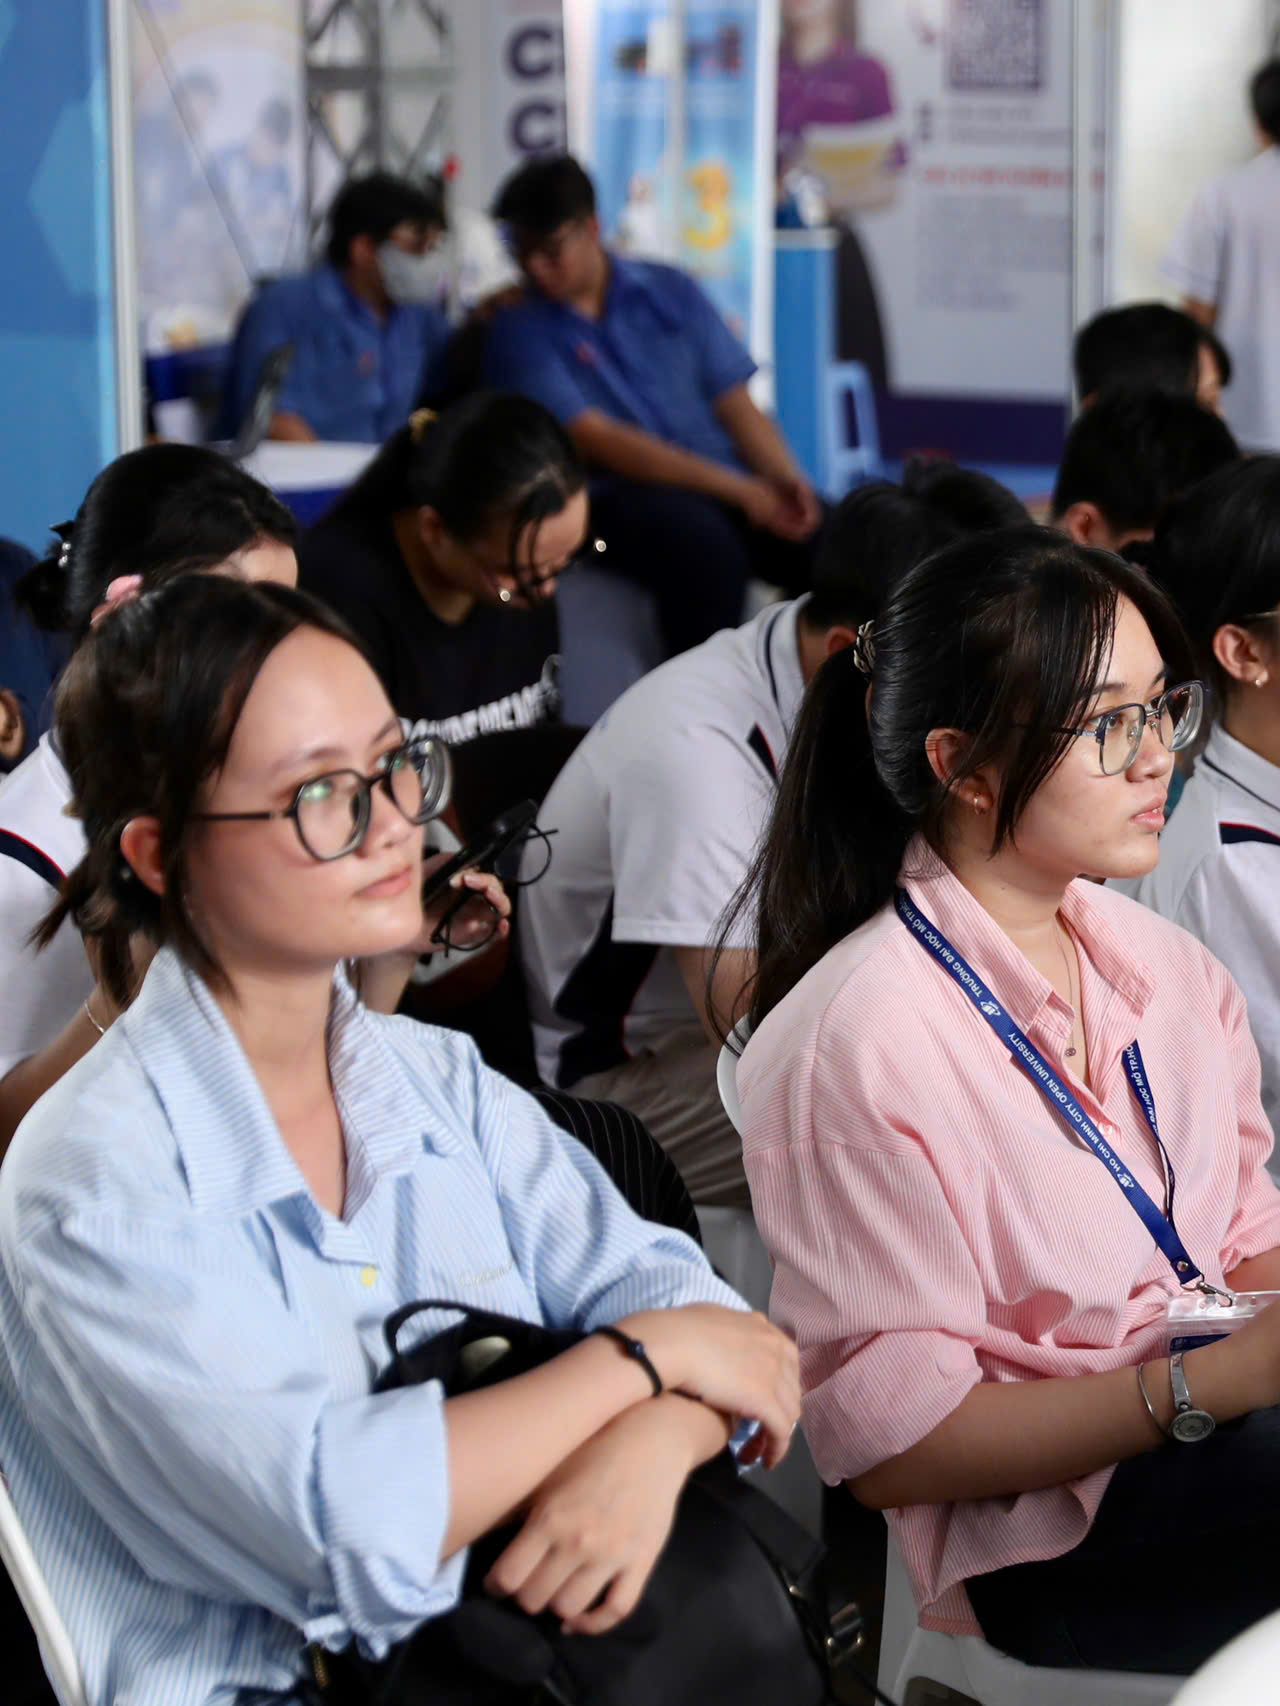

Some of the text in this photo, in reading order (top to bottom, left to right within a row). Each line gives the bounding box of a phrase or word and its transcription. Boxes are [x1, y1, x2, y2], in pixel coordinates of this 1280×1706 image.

[912, 919, 927, 933] MỞ
[924, 931, 942, 950] HỌC
[939, 947, 955, 963] ĐẠI
[952, 961, 983, 998] TRƯỜNG
[1008, 1032, 1121, 1173] HO CHI MINH CITY OPEN UNIVERSITY
